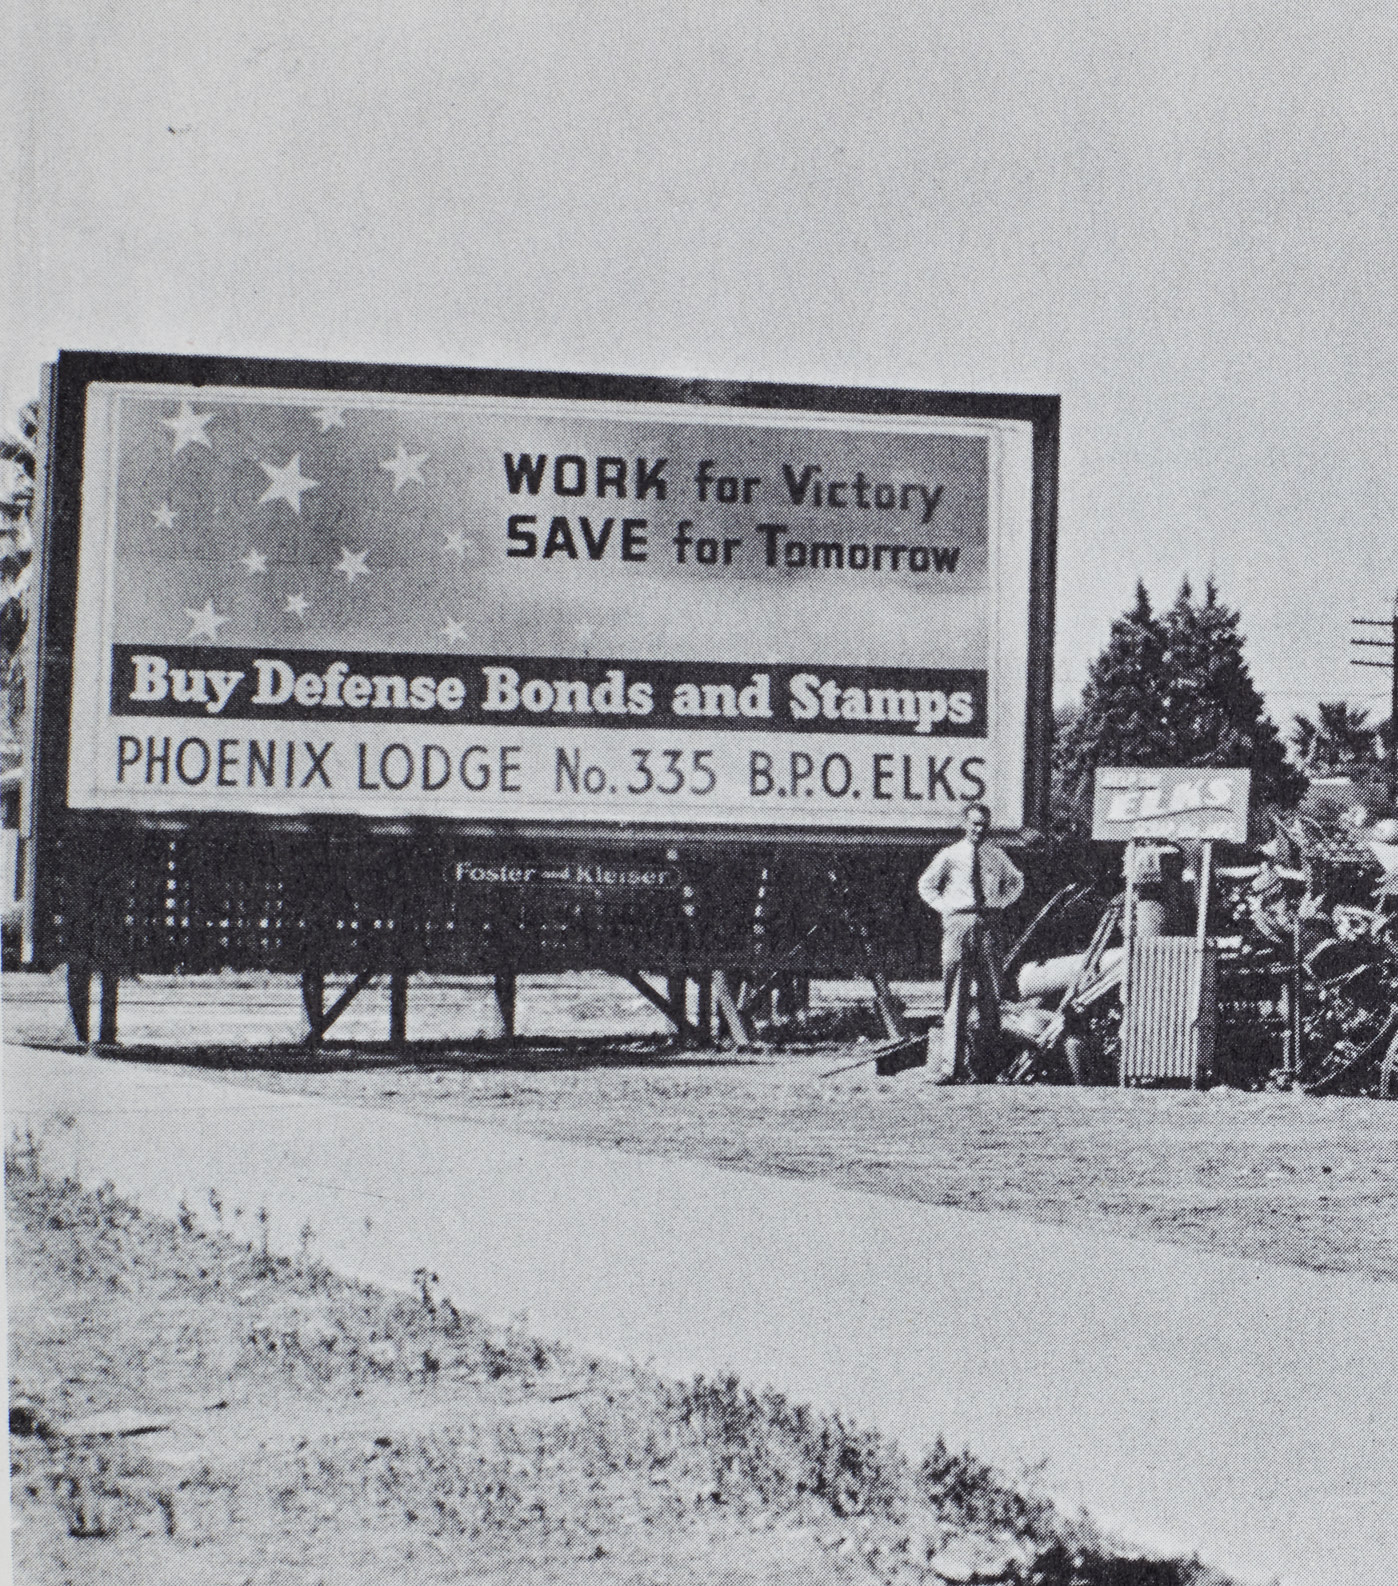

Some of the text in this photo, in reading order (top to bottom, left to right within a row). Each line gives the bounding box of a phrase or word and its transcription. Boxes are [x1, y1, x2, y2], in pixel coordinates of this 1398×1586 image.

[503, 453, 945, 524] WORK for Victory
[506, 514, 962, 573] SAVE for Tomorrow
[129, 655, 974, 733] Buy Defense Bonds and Stamps
[117, 735, 335, 789] PHOENIX
[358, 742, 522, 792] LODGE
[455, 862, 537, 883] Foster
[576, 865, 670, 885] Kleiser
